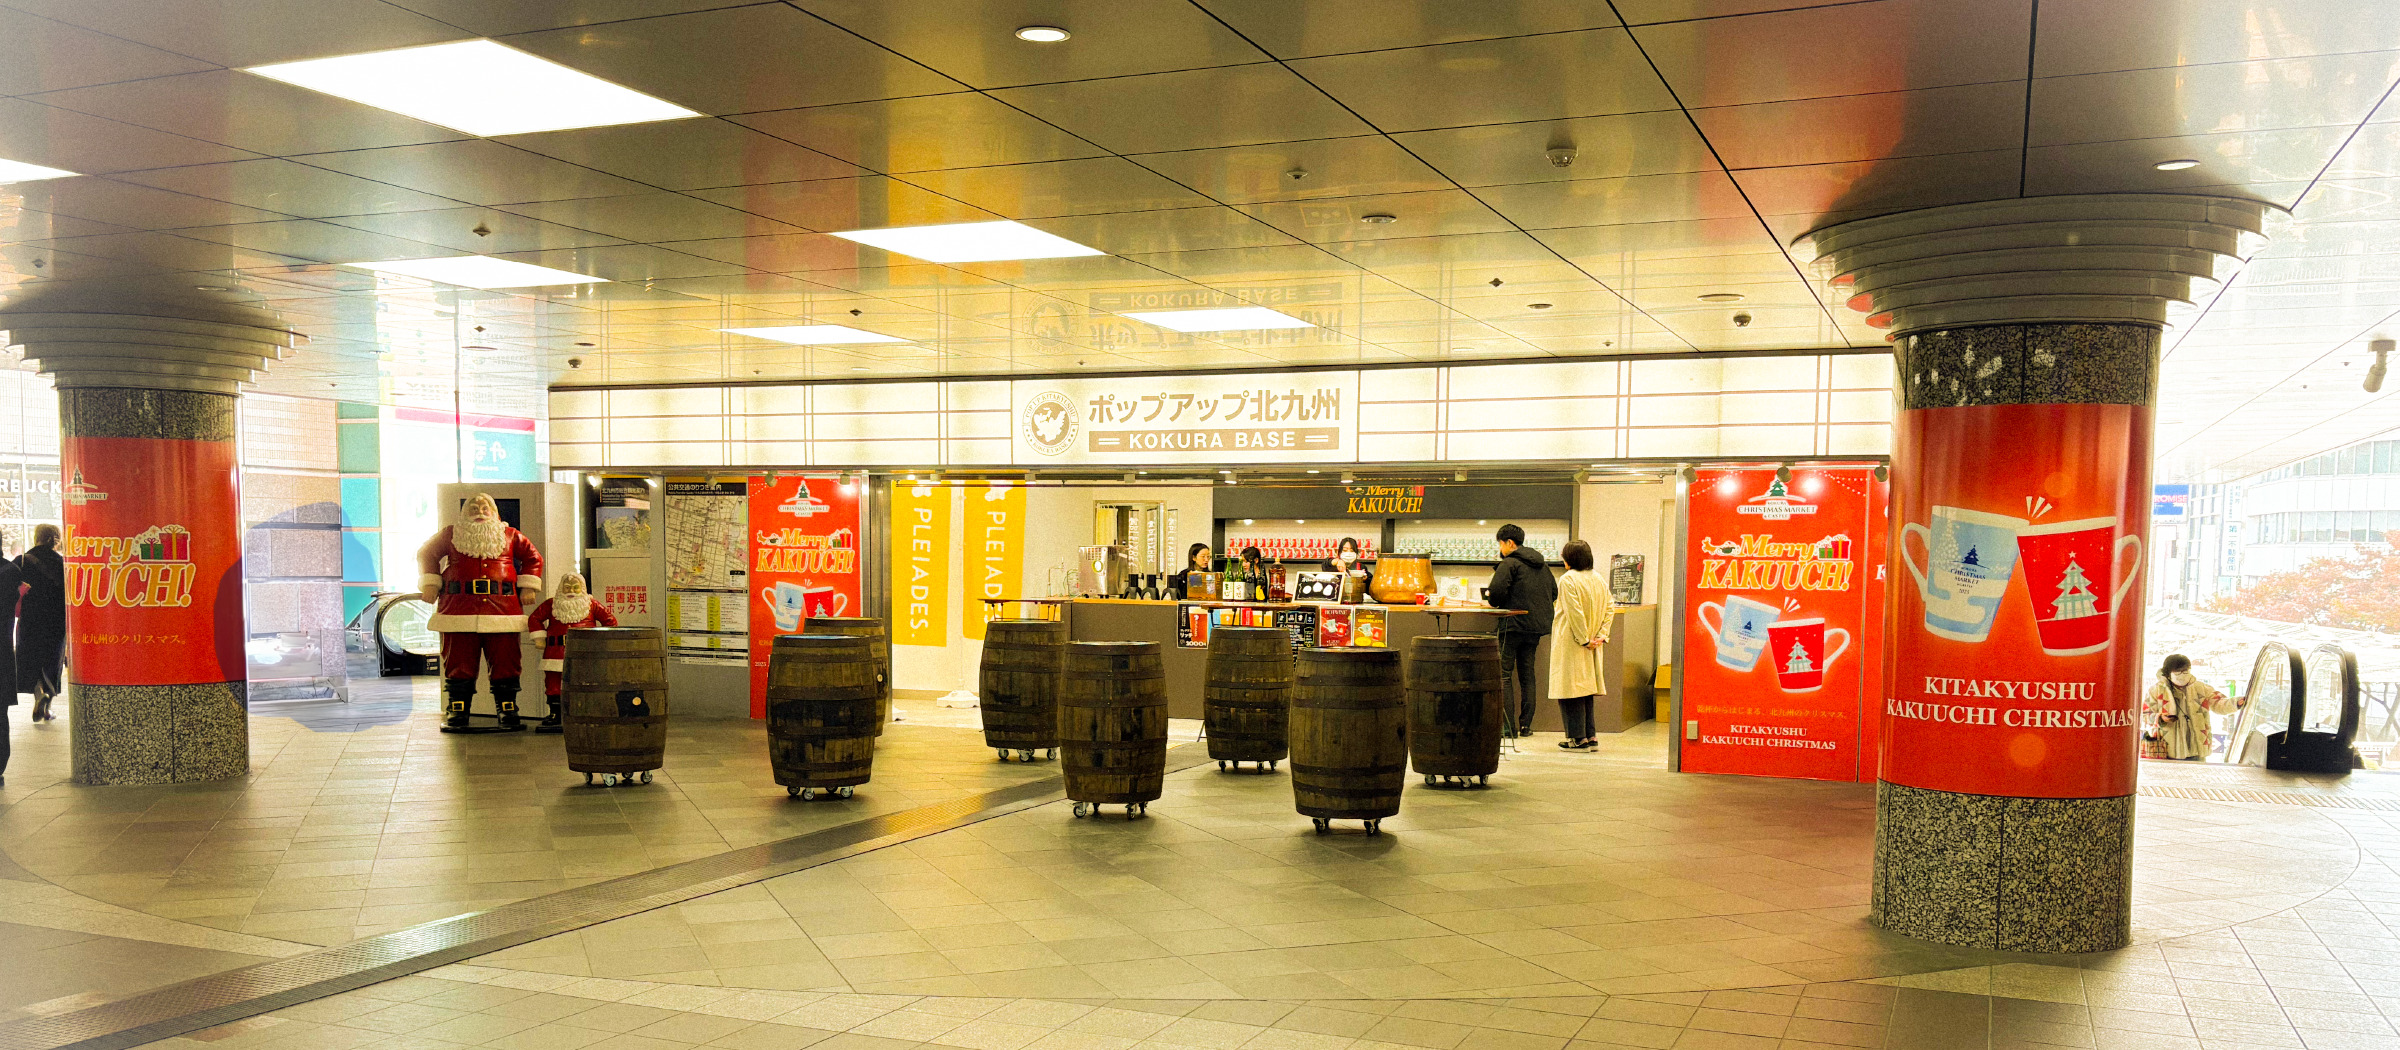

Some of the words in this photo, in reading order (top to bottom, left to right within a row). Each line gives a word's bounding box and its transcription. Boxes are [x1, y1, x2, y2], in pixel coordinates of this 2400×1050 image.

[1089, 388, 1340, 423] ポップアップ北九州
[1129, 432, 1224, 450] KOKURA
[1235, 431, 1295, 448] BASE
[1365, 486, 1405, 497] Merry
[1347, 497, 1424, 513] KAKUUCH!
[780, 528, 830, 550] Merry
[1741, 535, 1815, 561] Merry
[755, 548, 855, 574] KAKUUCH!
[1698, 560, 1854, 591] KAKUUCH!
[605, 593, 647, 603] 図書返却
[606, 604, 647, 614] ボックス
[1924, 676, 2096, 701] KITAKYUSHU
[1887, 698, 1998, 726] KAKUUCHI
[2003, 708, 2134, 728] CHRISTMAS
[1730, 724, 1808, 737] KITAKYUSHU
[1702, 735, 1764, 747] KAKUUCHI
[1766, 738, 1836, 750] CHRISTMAS
